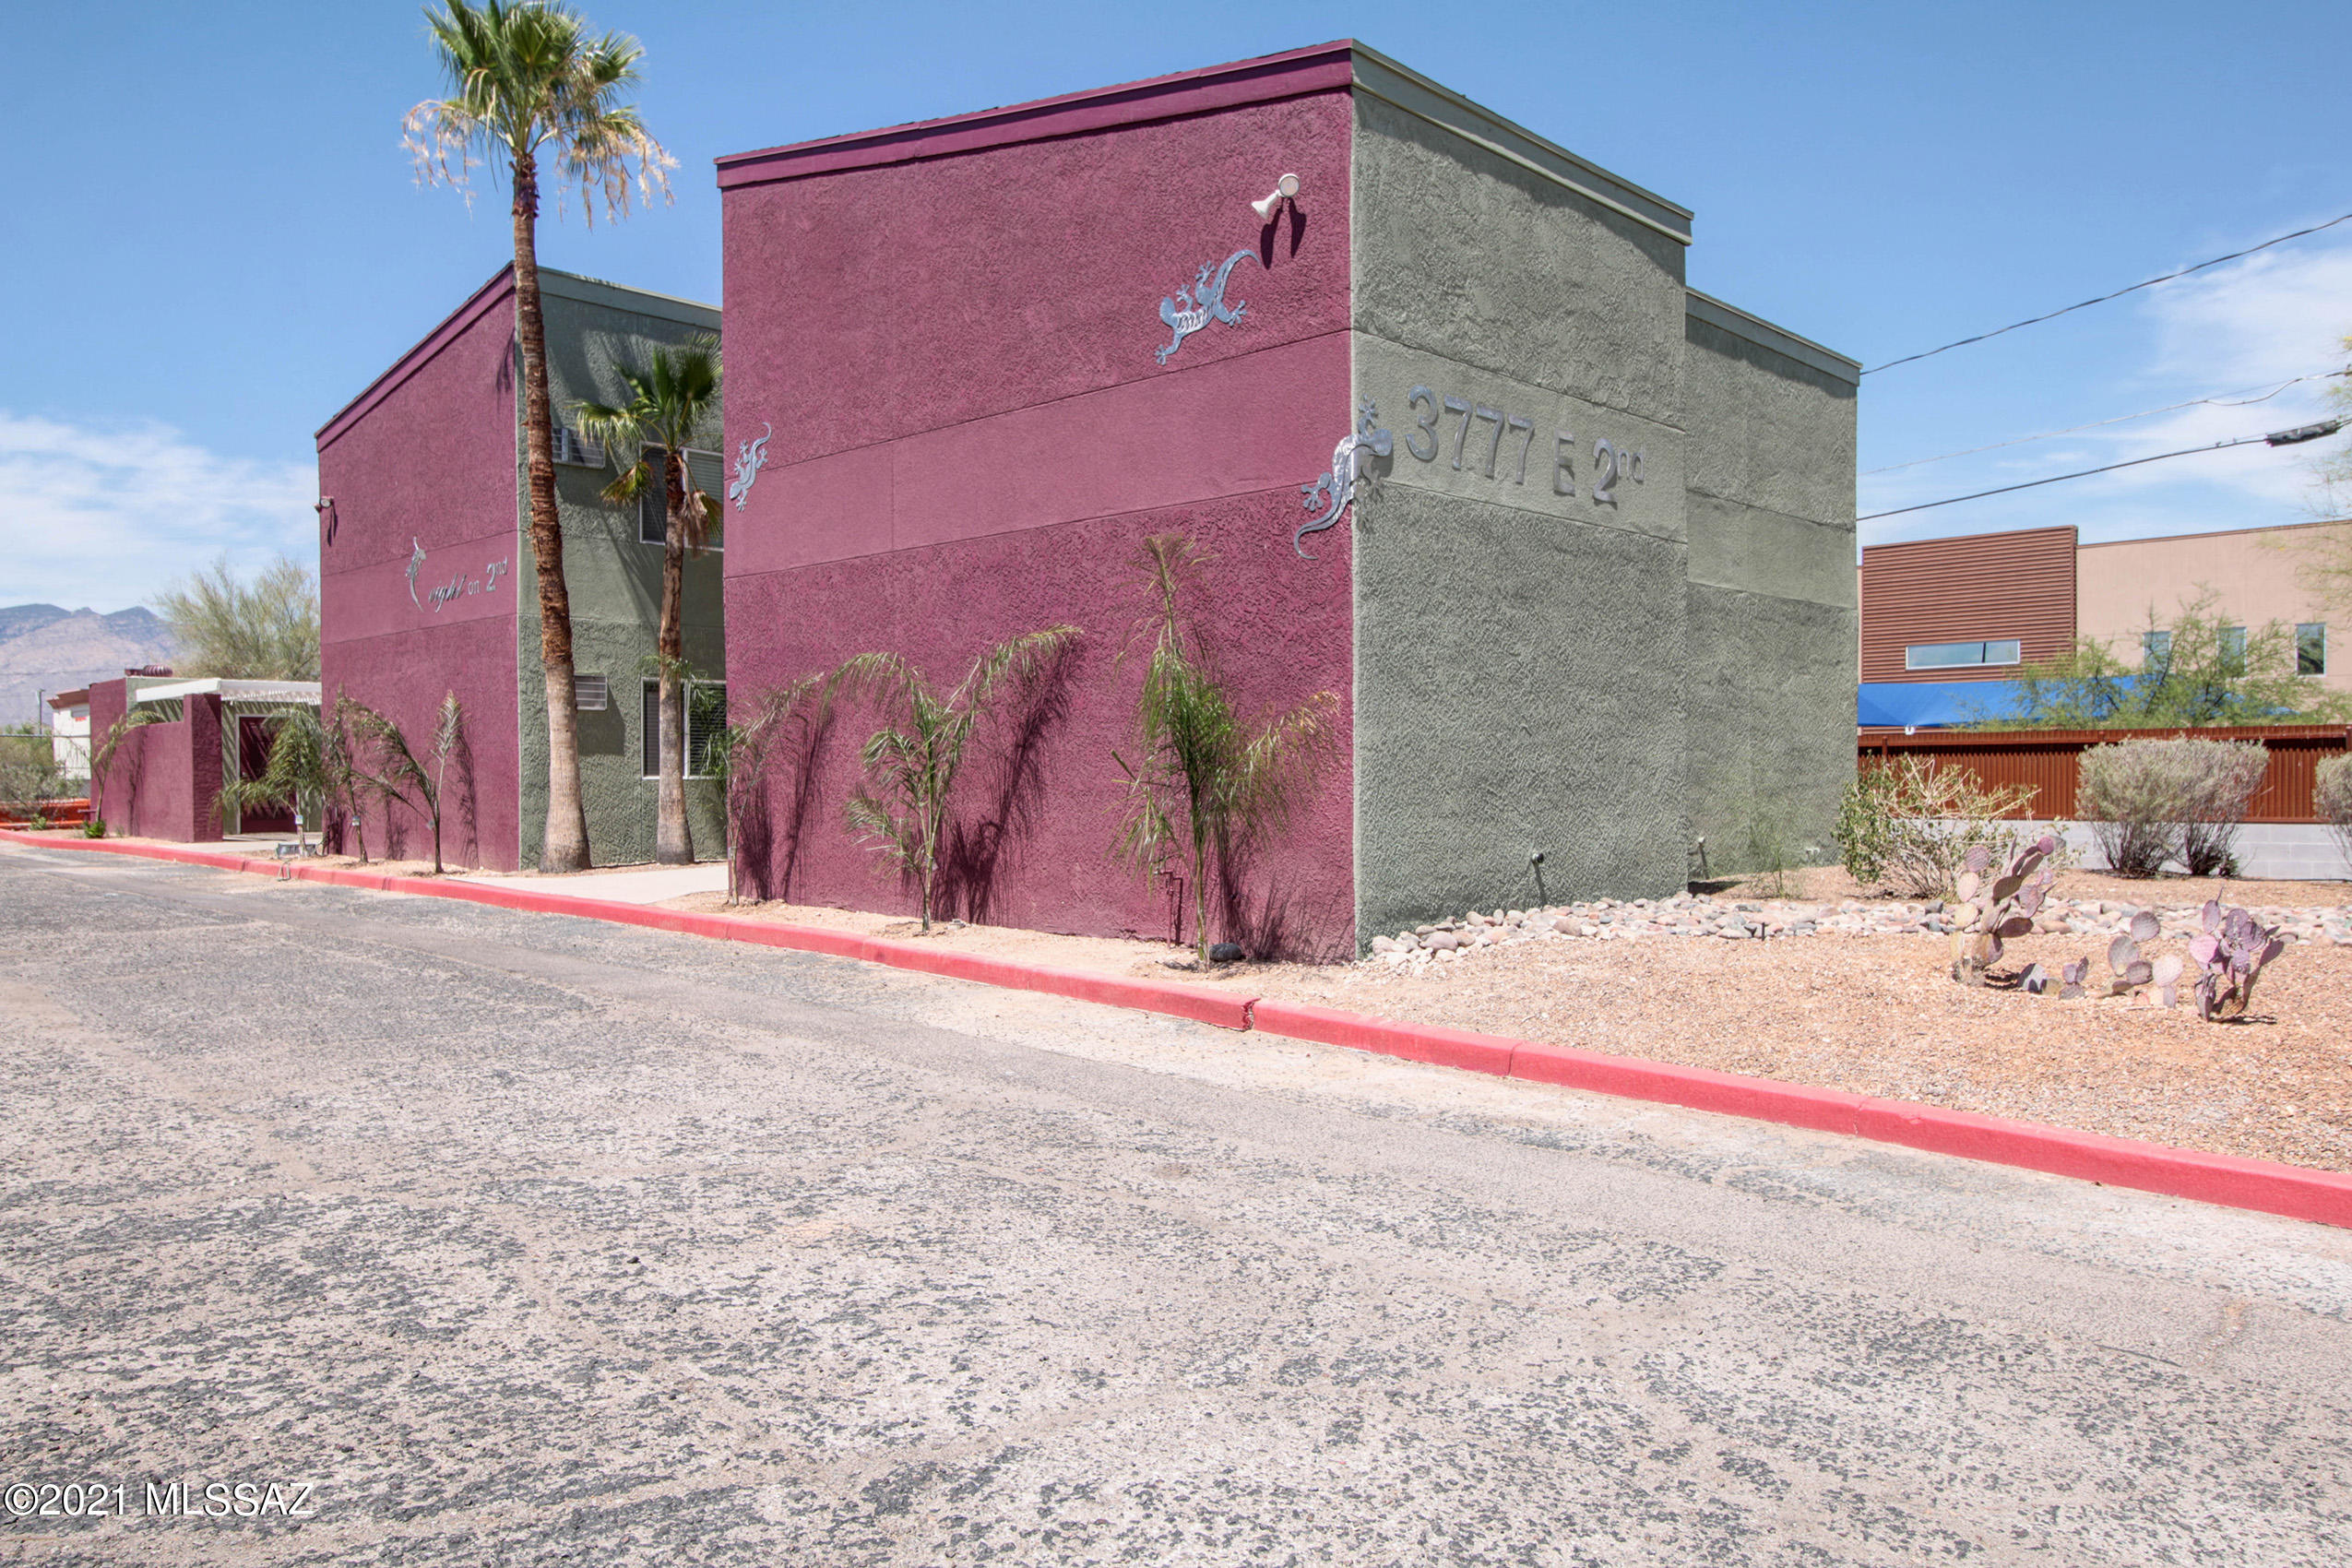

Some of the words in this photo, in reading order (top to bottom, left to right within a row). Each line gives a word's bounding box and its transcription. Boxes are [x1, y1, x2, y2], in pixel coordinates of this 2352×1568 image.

[1407, 385, 1534, 484] 3777
[1553, 428, 1575, 495] E
[1593, 438, 1645, 503] 2nd
[468, 580, 480, 596] on
[486, 556, 508, 592] 2nd
